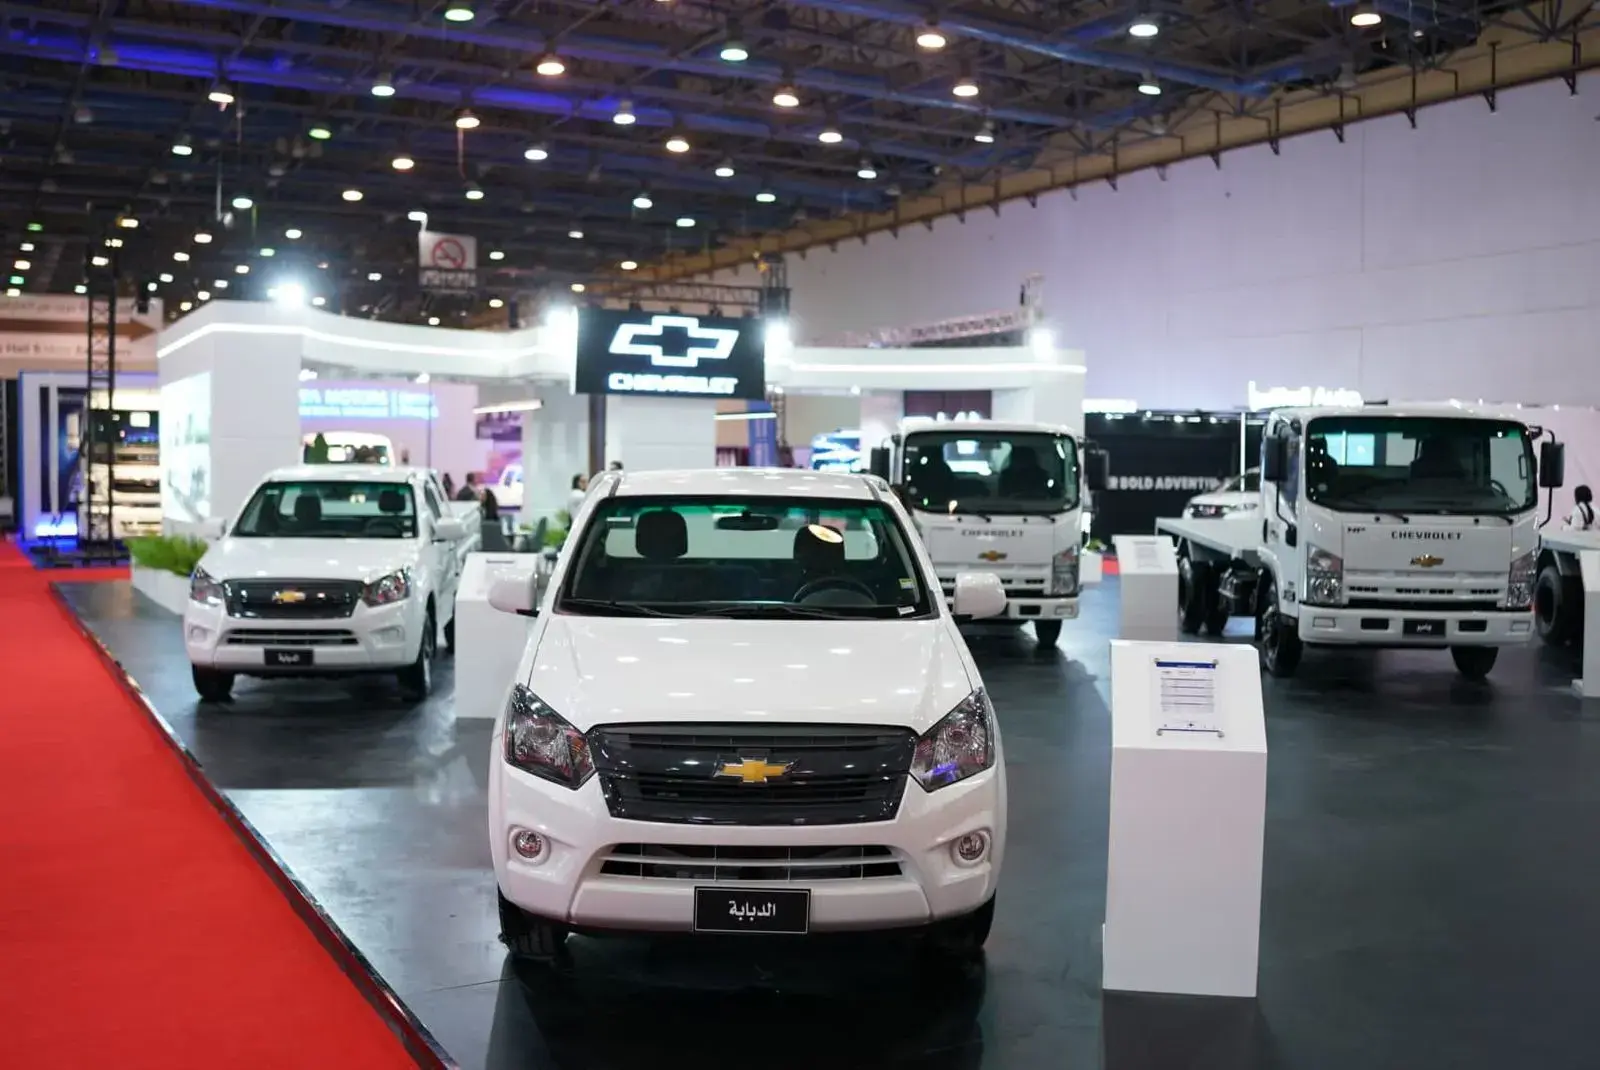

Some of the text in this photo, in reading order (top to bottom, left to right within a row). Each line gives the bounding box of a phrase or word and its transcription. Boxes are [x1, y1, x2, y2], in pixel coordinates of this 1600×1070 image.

[1119, 476, 1154, 490] BOLD
[1391, 531, 1462, 540] CHEVROLET
[728, 900, 776, 921] الدبابة
